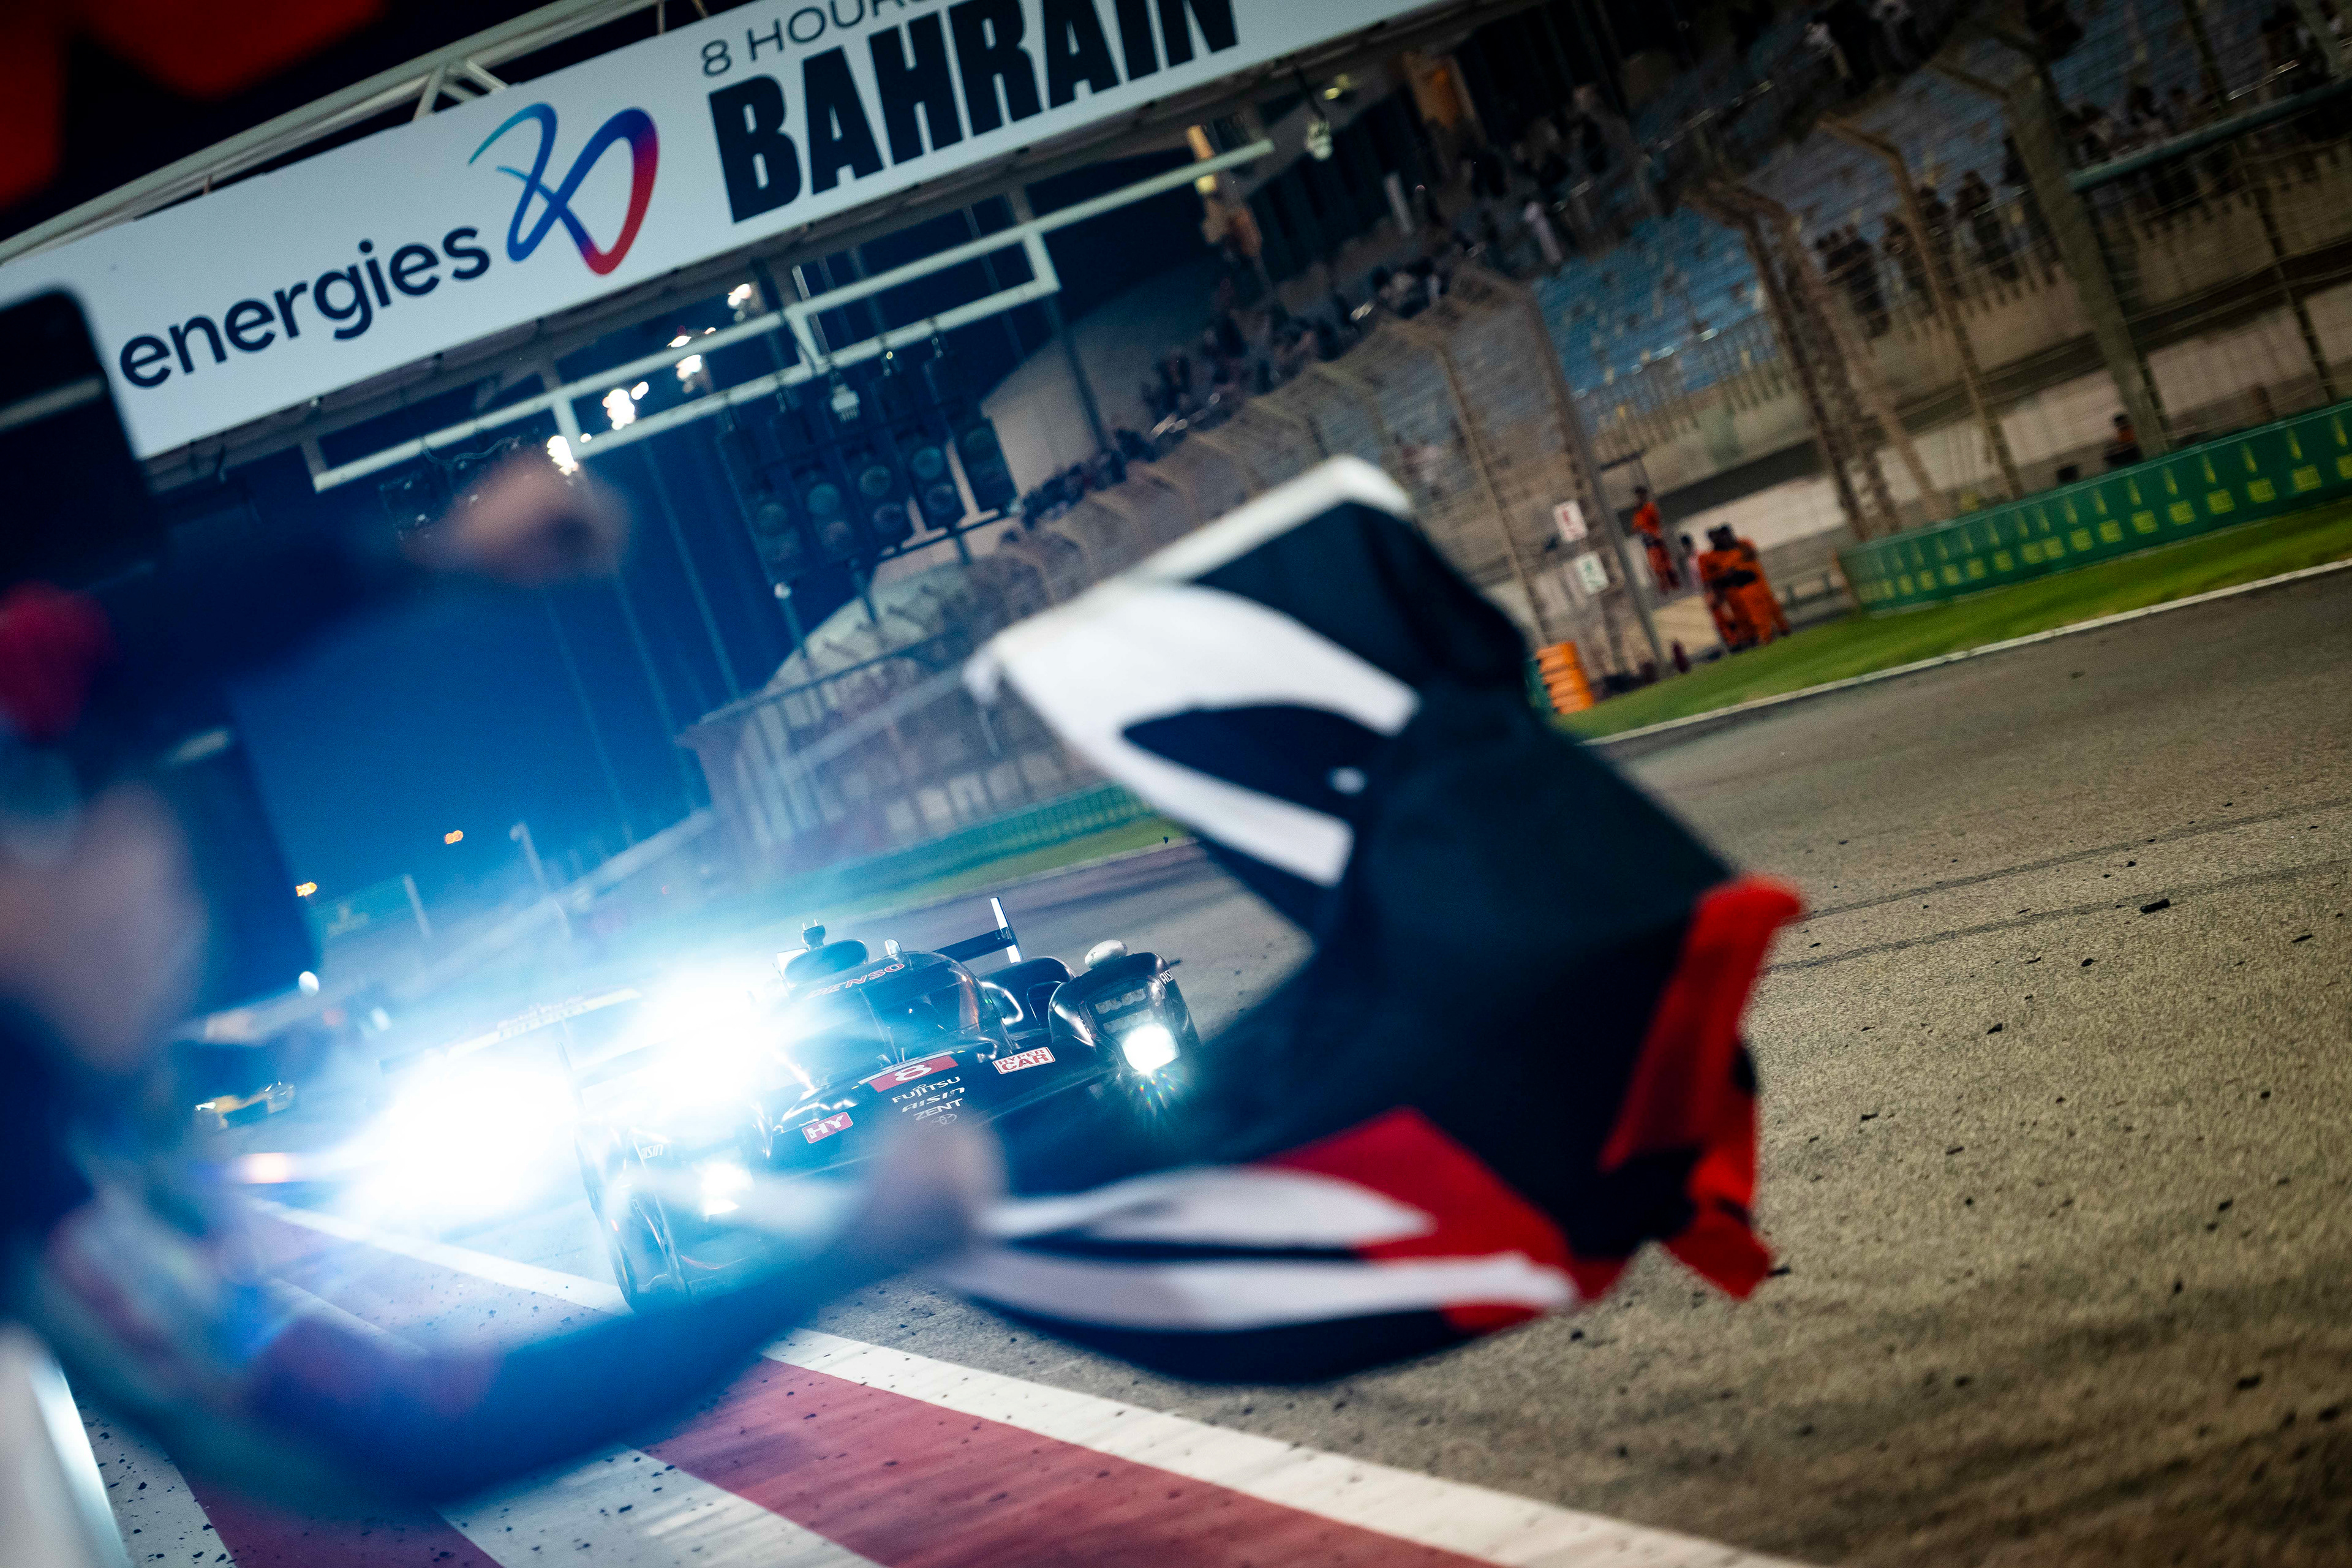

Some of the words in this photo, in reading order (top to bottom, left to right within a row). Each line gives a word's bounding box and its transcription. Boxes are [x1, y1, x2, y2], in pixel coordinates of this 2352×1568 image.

[701, 39, 733, 77] 8
[745, 0, 925, 62] HOU
[119, 226, 491, 388] energies
[802, 963, 905, 1000] DENSO
[998, 1049, 1045, 1065] HYPER
[1001, 1054, 1049, 1071] CAR
[894, 1065, 932, 1082] 8
[891, 1076, 961, 1103] FUJITSU
[913, 1098, 963, 1121] ZENT
[806, 1115, 844, 1139] HY
